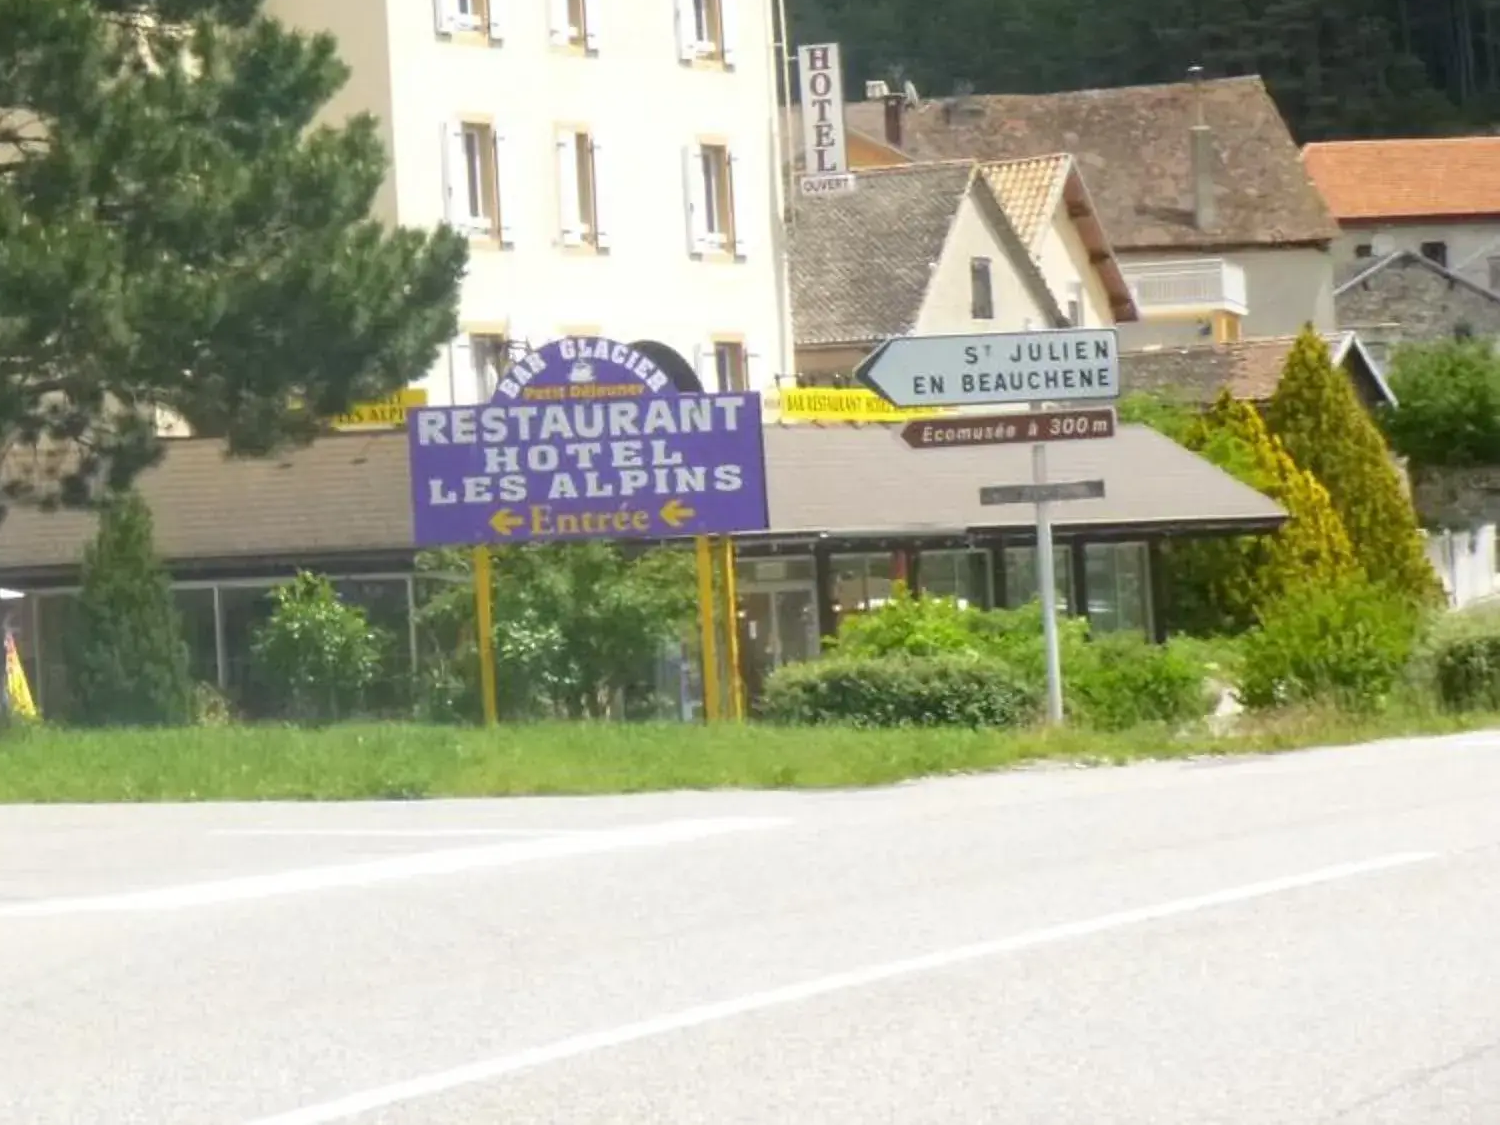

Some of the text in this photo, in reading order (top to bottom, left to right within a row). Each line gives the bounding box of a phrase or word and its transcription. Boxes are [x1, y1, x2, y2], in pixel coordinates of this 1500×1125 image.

[806, 47, 837, 172] HOTEL
[803, 177, 849, 193] OUVERT
[499, 338, 668, 399] BAR GLACIER
[1010, 340, 1109, 363] JULIEN
[913, 368, 1110, 394] EN BEAUCHENE
[418, 396, 745, 445] RESTAURANT
[922, 423, 1016, 442] Ecomusée
[1028, 422, 1039, 436] à
[484, 439, 682, 474] HOTEL
[429, 464, 743, 505] LES ALPINS
[529, 503, 650, 536] Entrée
